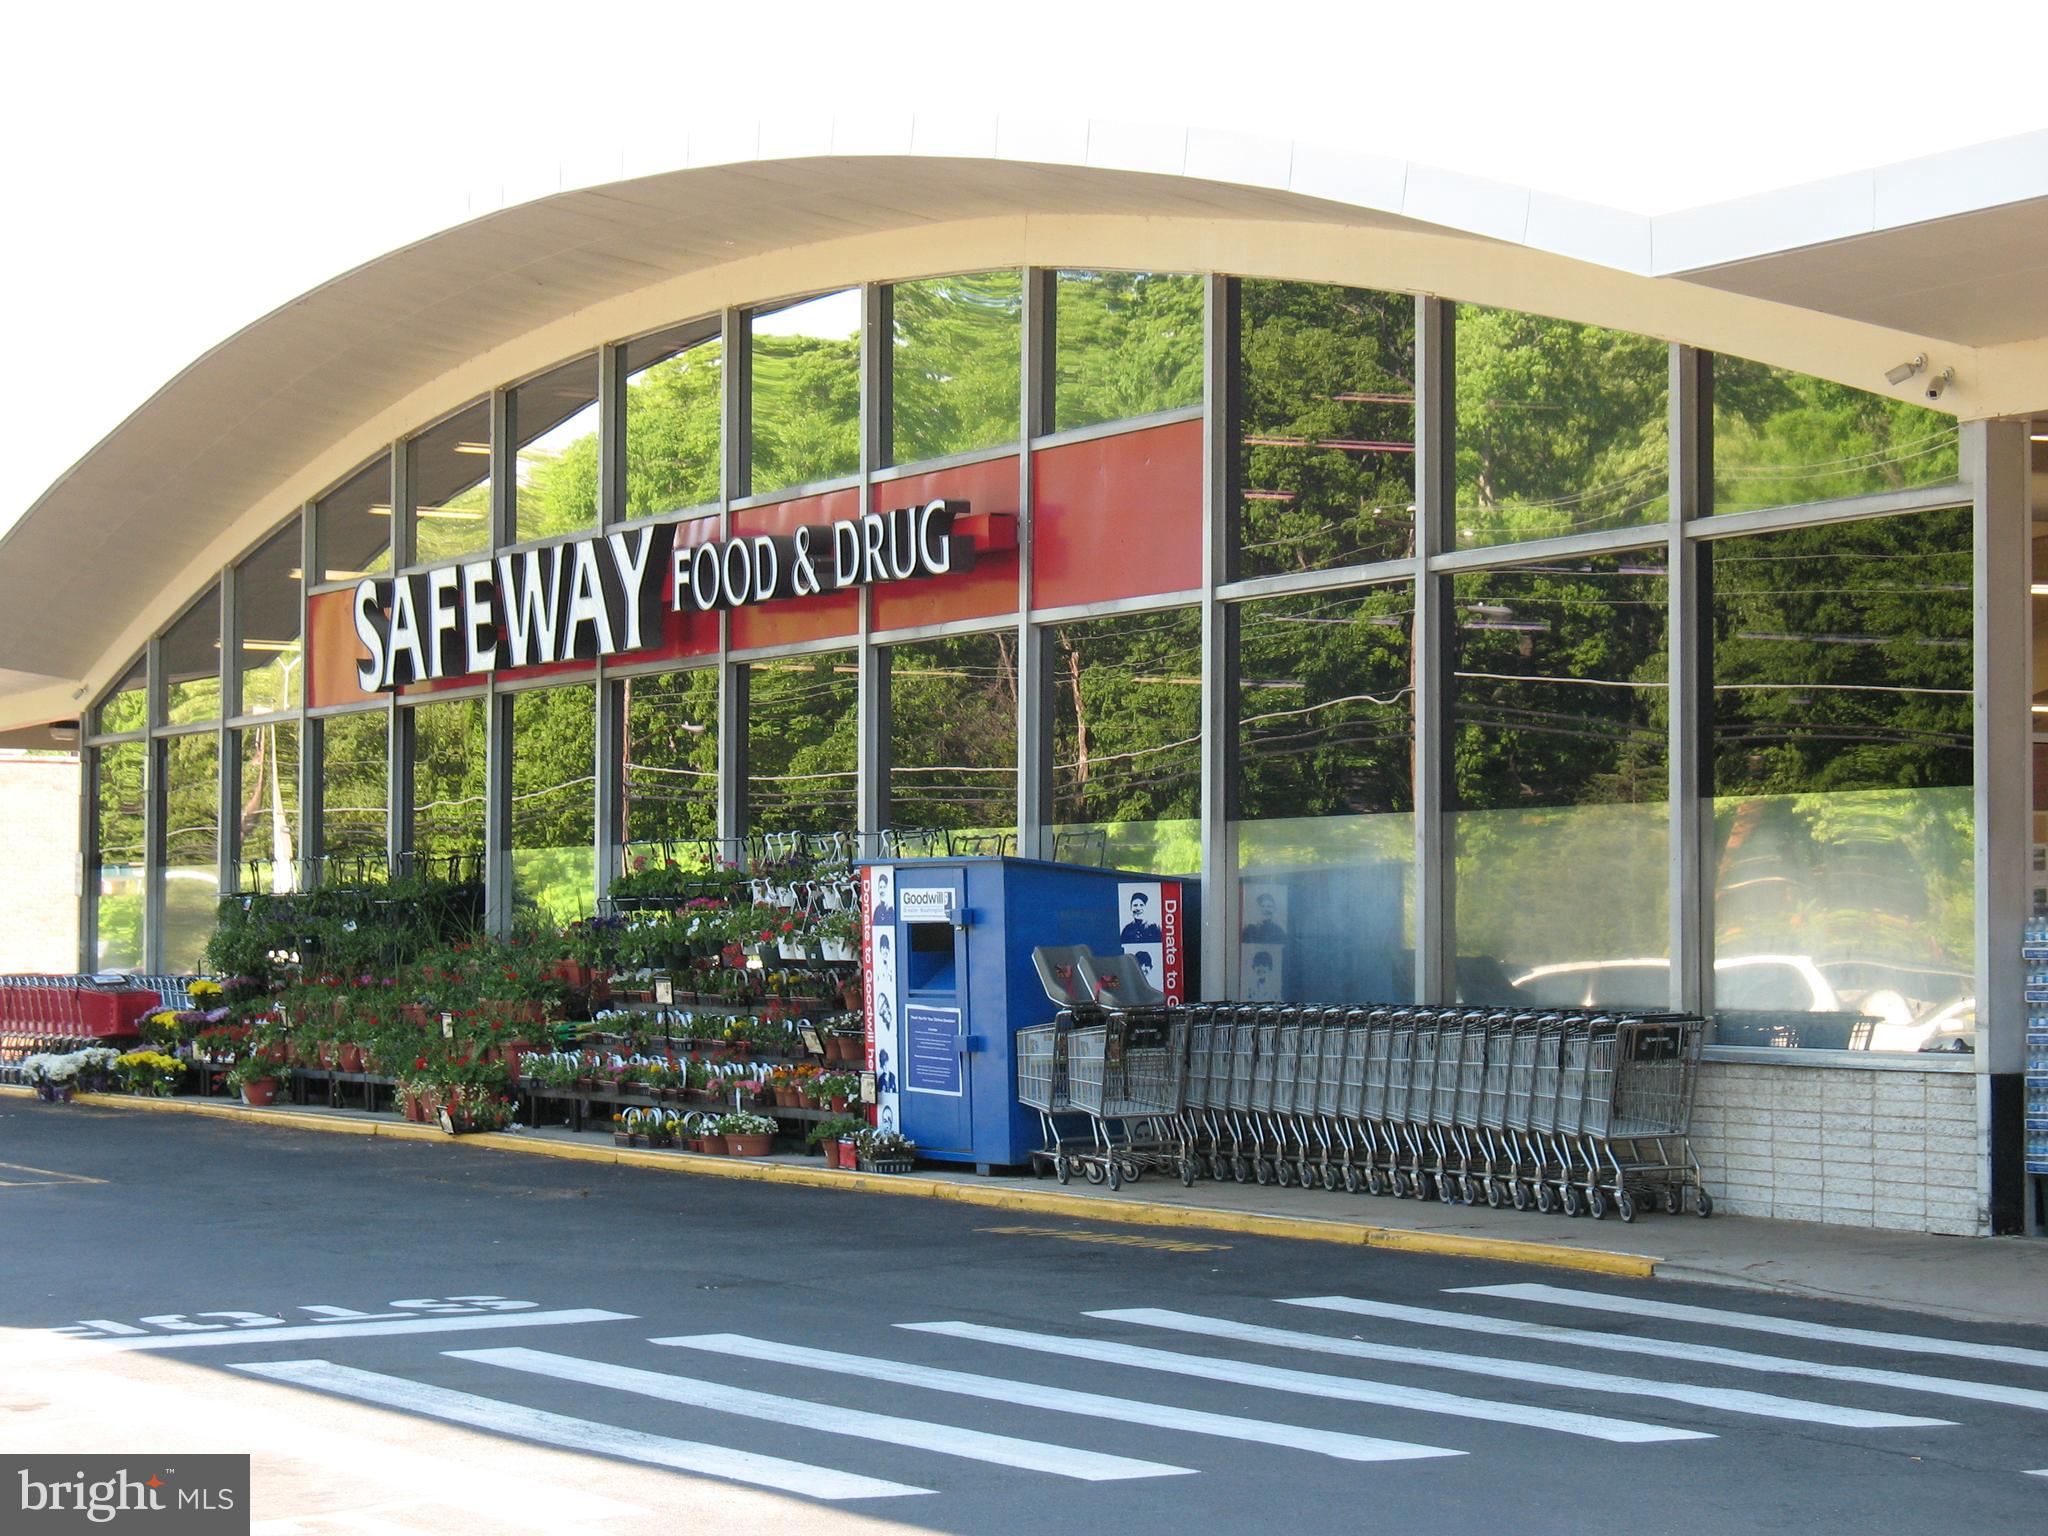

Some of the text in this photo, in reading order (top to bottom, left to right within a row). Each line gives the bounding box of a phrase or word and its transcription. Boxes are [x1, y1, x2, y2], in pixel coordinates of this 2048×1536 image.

[353, 499, 951, 693] SAFEWAY FOOD & DRUG
[863, 879, 871, 942] Donate
[903, 891, 944, 905] Goodwill
[1164, 899, 1178, 966] Donate
[865, 969, 874, 1044] Goodwill
[1166, 970, 1178, 990] to
